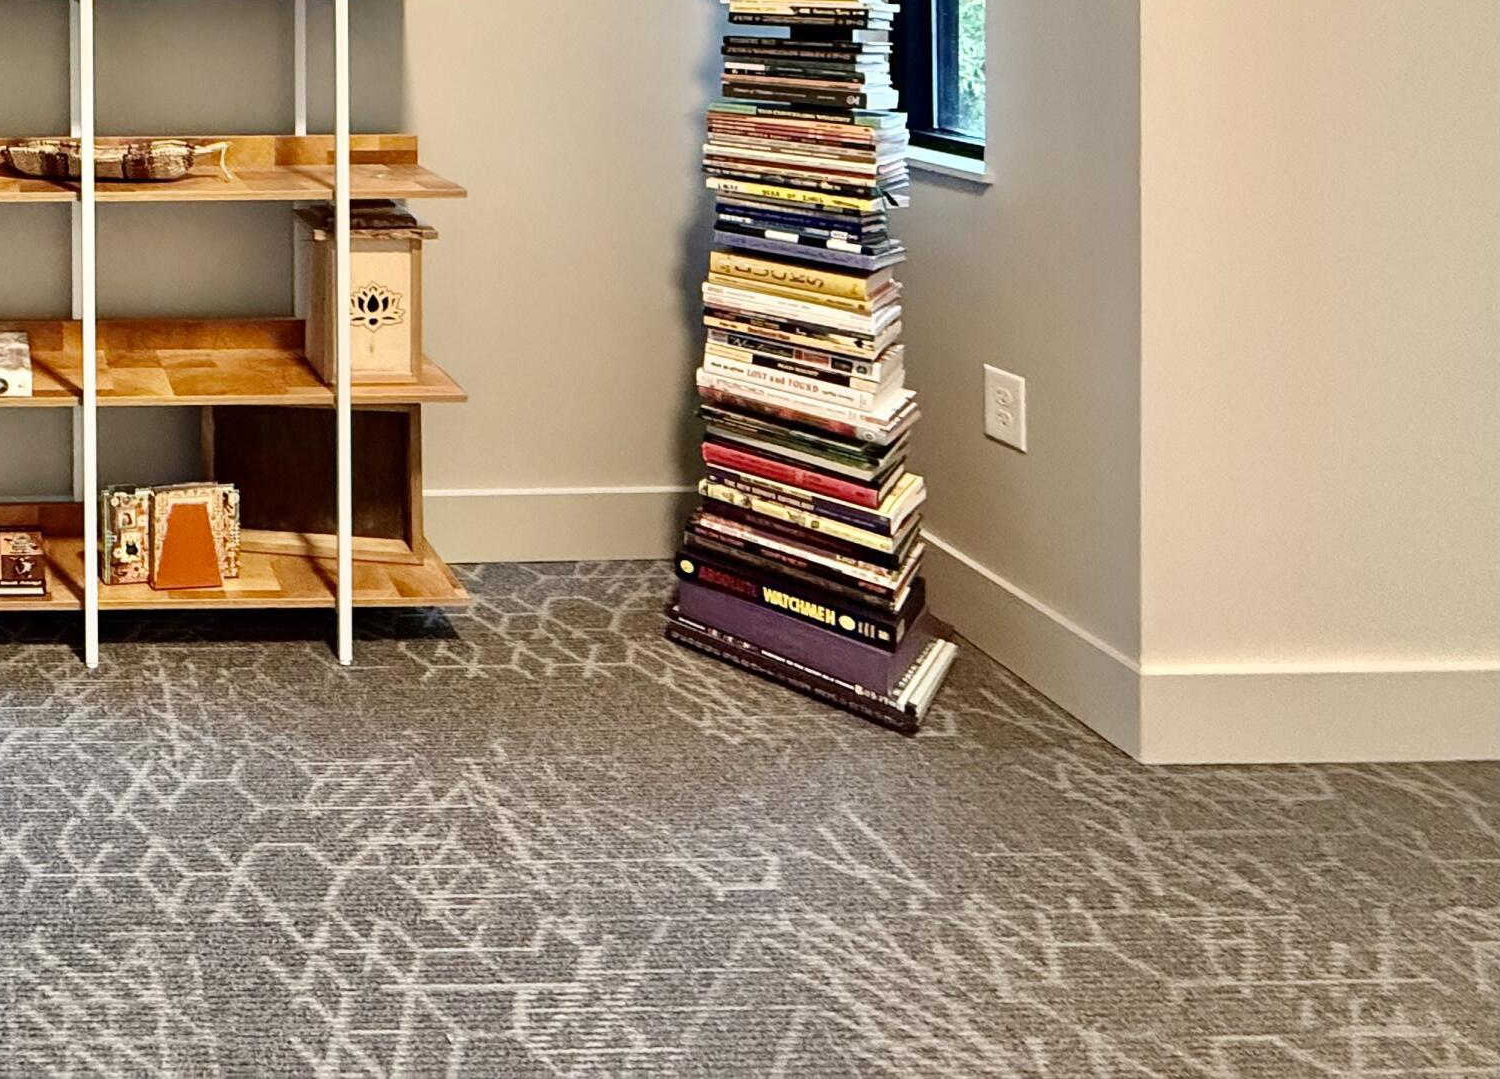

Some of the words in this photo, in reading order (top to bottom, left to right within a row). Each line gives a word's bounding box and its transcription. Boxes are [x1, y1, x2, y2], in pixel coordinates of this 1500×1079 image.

[746, 369, 768, 381] LOST
[788, 378, 820, 393] FOUND
[762, 586, 836, 626] WATCHMEN
